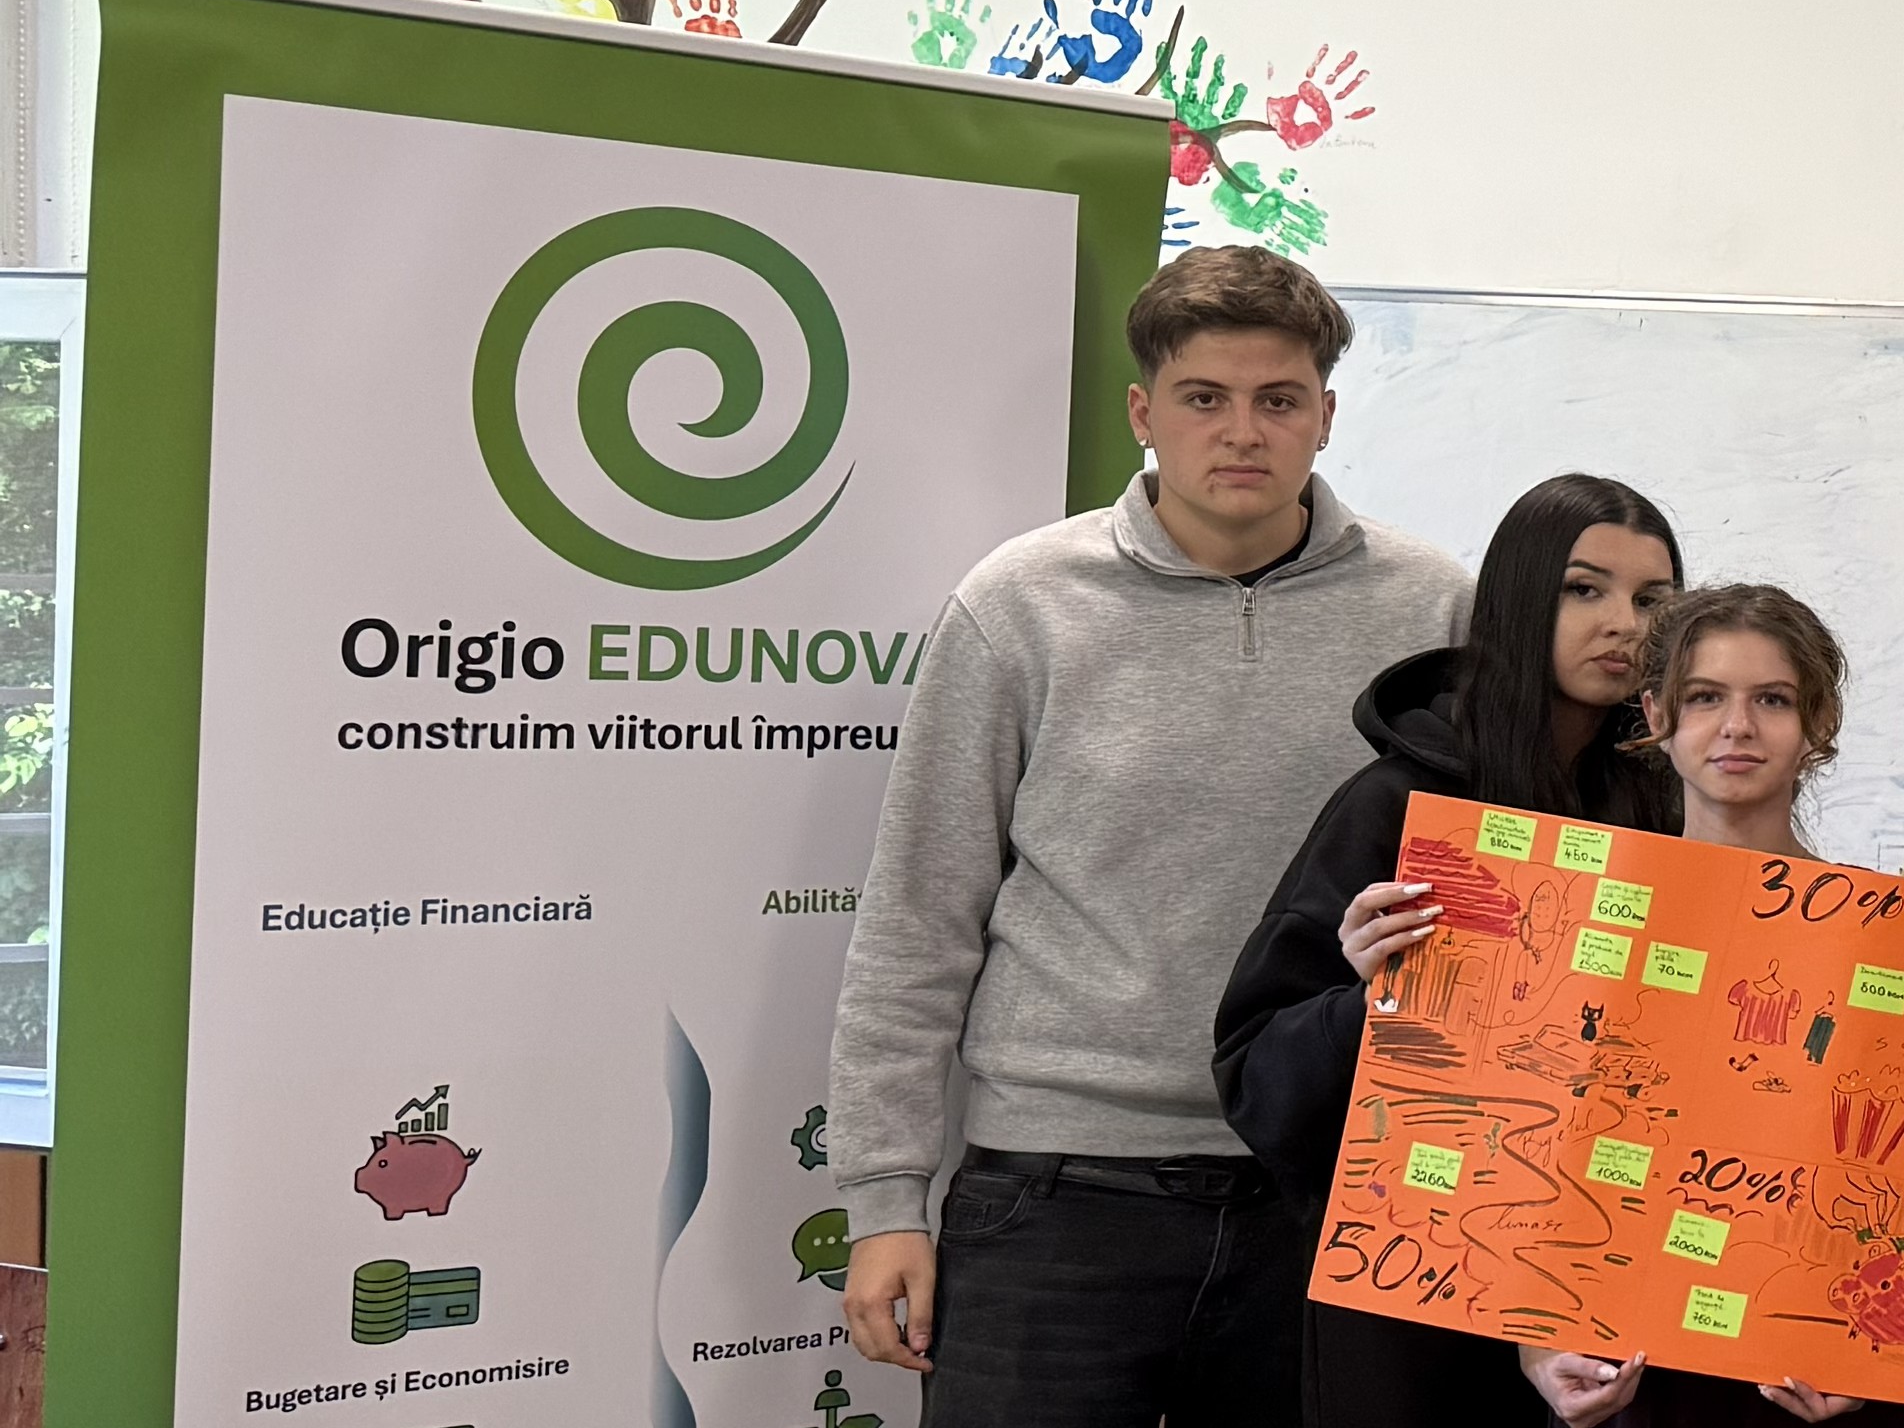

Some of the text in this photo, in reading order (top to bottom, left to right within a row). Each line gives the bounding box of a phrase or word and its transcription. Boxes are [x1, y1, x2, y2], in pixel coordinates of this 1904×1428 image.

[340, 618, 565, 694] Origio
[337, 714, 899, 758] construim viitorul împreu
[261, 894, 593, 935] Educație Financiară
[762, 889, 863, 916] Abilită
[1598, 900, 1631, 918] 600
[1752, 859, 1904, 928] 30%
[1596, 1167, 1630, 1183] 1000
[1679, 1148, 1786, 1203] 20%
[1324, 1221, 1459, 1306] 50%
[1669, 1235, 1704, 1256] 2000
[693, 1331, 822, 1362] Rezolvarea
[246, 1356, 570, 1413] Bugetare și Economisire
